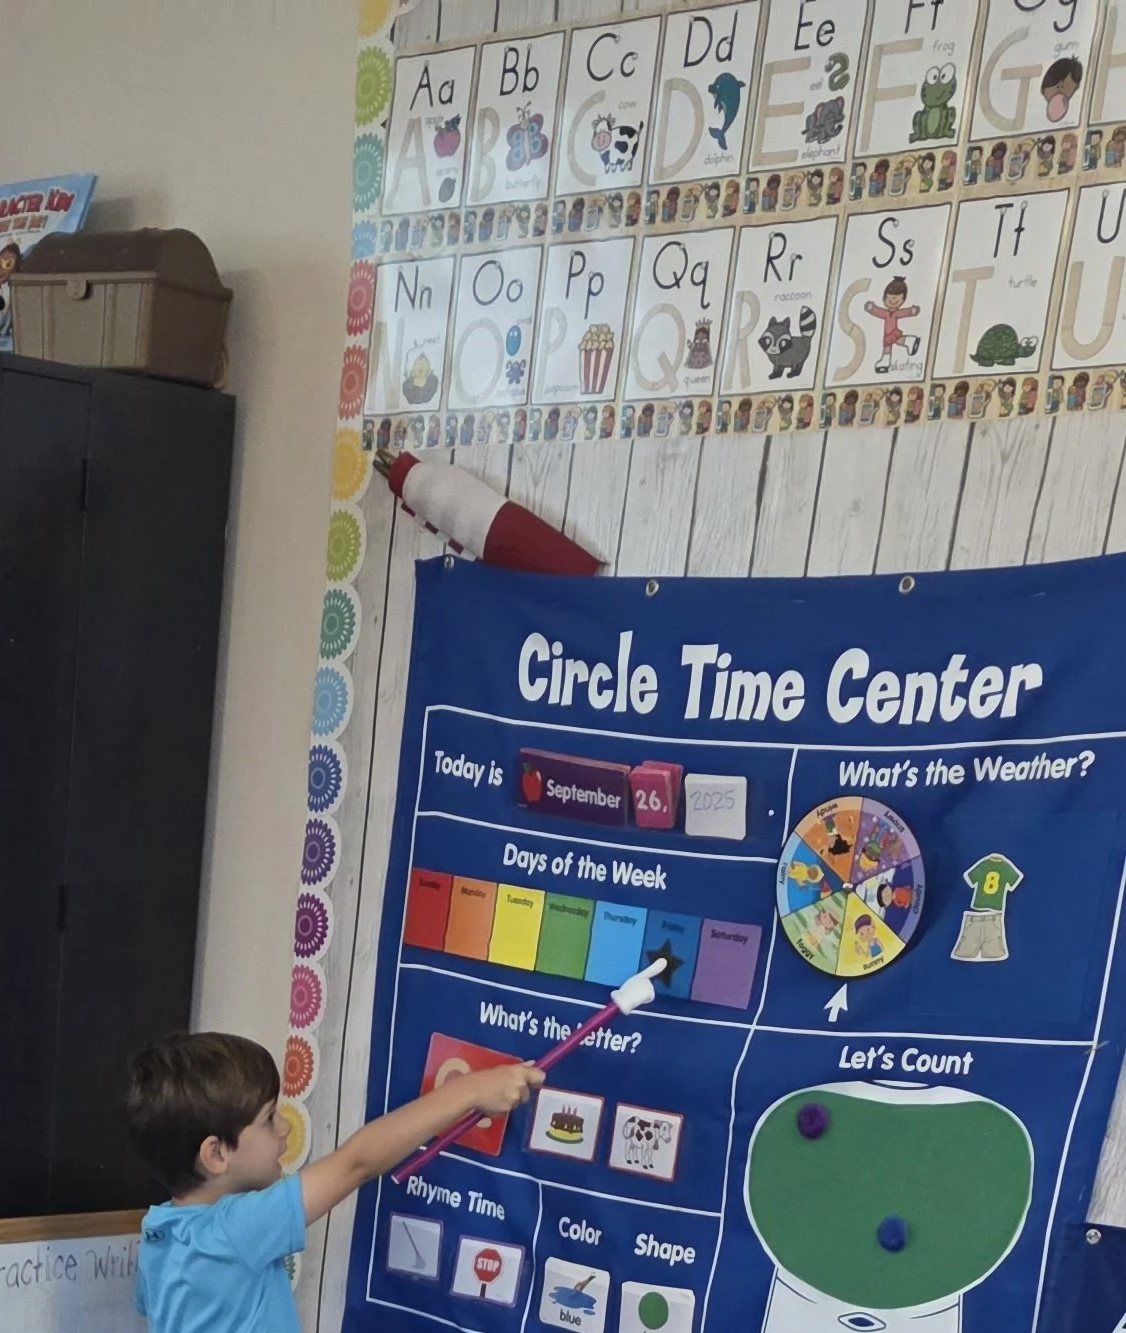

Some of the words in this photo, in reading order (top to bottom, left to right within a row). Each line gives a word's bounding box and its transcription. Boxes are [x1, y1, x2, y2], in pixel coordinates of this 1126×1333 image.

[683, 9, 739, 68] Dd
[794, 0, 836, 51] Ee
[587, 32, 639, 82] Cc
[931, 39, 956, 56] frog
[409, 64, 455, 111] Aa
[499, 44, 540, 96] Bb
[618, 101, 637, 109] cow
[751, 56, 812, 167] E
[860, 37, 924, 152] F
[567, 90, 606, 187] C
[653, 77, 705, 181] D
[704, 153, 735, 168] dolphin
[801, 143, 841, 161] elephant
[505, 174, 542, 191] butterfly
[872, 217, 915, 269] Ss
[993, 200, 1028, 258] Tt
[653, 241, 711, 310] Qq
[763, 231, 803, 283] Rr
[394, 265, 433, 312] Nn
[472, 260, 523, 306] Oo
[566, 249, 604, 320] Pp
[774, 291, 813, 301] raccoon
[1008, 275, 1038, 288] turtle
[952, 265, 995, 374] T
[683, 376, 711, 390] queen
[518, 629, 660, 715] Circle
[681, 643, 805, 720] Time
[826, 647, 1044, 726] Center
[434, 750, 484, 788] Today
[488, 759, 503, 786] is
[546, 779, 621, 809] September
[838, 759, 919, 788] What's
[925, 756, 965, 785] the
[974, 750, 1096, 783] Weather?
[689, 789, 736, 812] 2025
[816, 802, 839, 817] windy
[503, 843, 547, 876] Days
[551, 852, 574, 876] of
[577, 855, 607, 882] the
[612, 860, 667, 891] Week
[983, 871, 1000, 895] 8
[461, 886, 487, 899] Monday
[506, 894, 534, 909] Tuesday
[549, 902, 590, 919] Wednesday
[603, 911, 638, 927] Thursday
[710, 929, 749, 946] Saturday
[862, 956, 885, 971] sunny
[480, 1001, 539, 1036] What's
[543, 1016, 571, 1041] the
[838, 1045, 895, 1071] Let's
[901, 1047, 974, 1075] Count
[407, 1175, 461, 1209] Rhyme
[468, 1191, 506, 1221] Time
[558, 1216, 602, 1246] Color
[634, 1233, 696, 1266] Shape
[85, 1240, 141, 1280] Writi
[475, 1257, 500, 1273] STOP
[559, 1308, 582, 1327] blue
